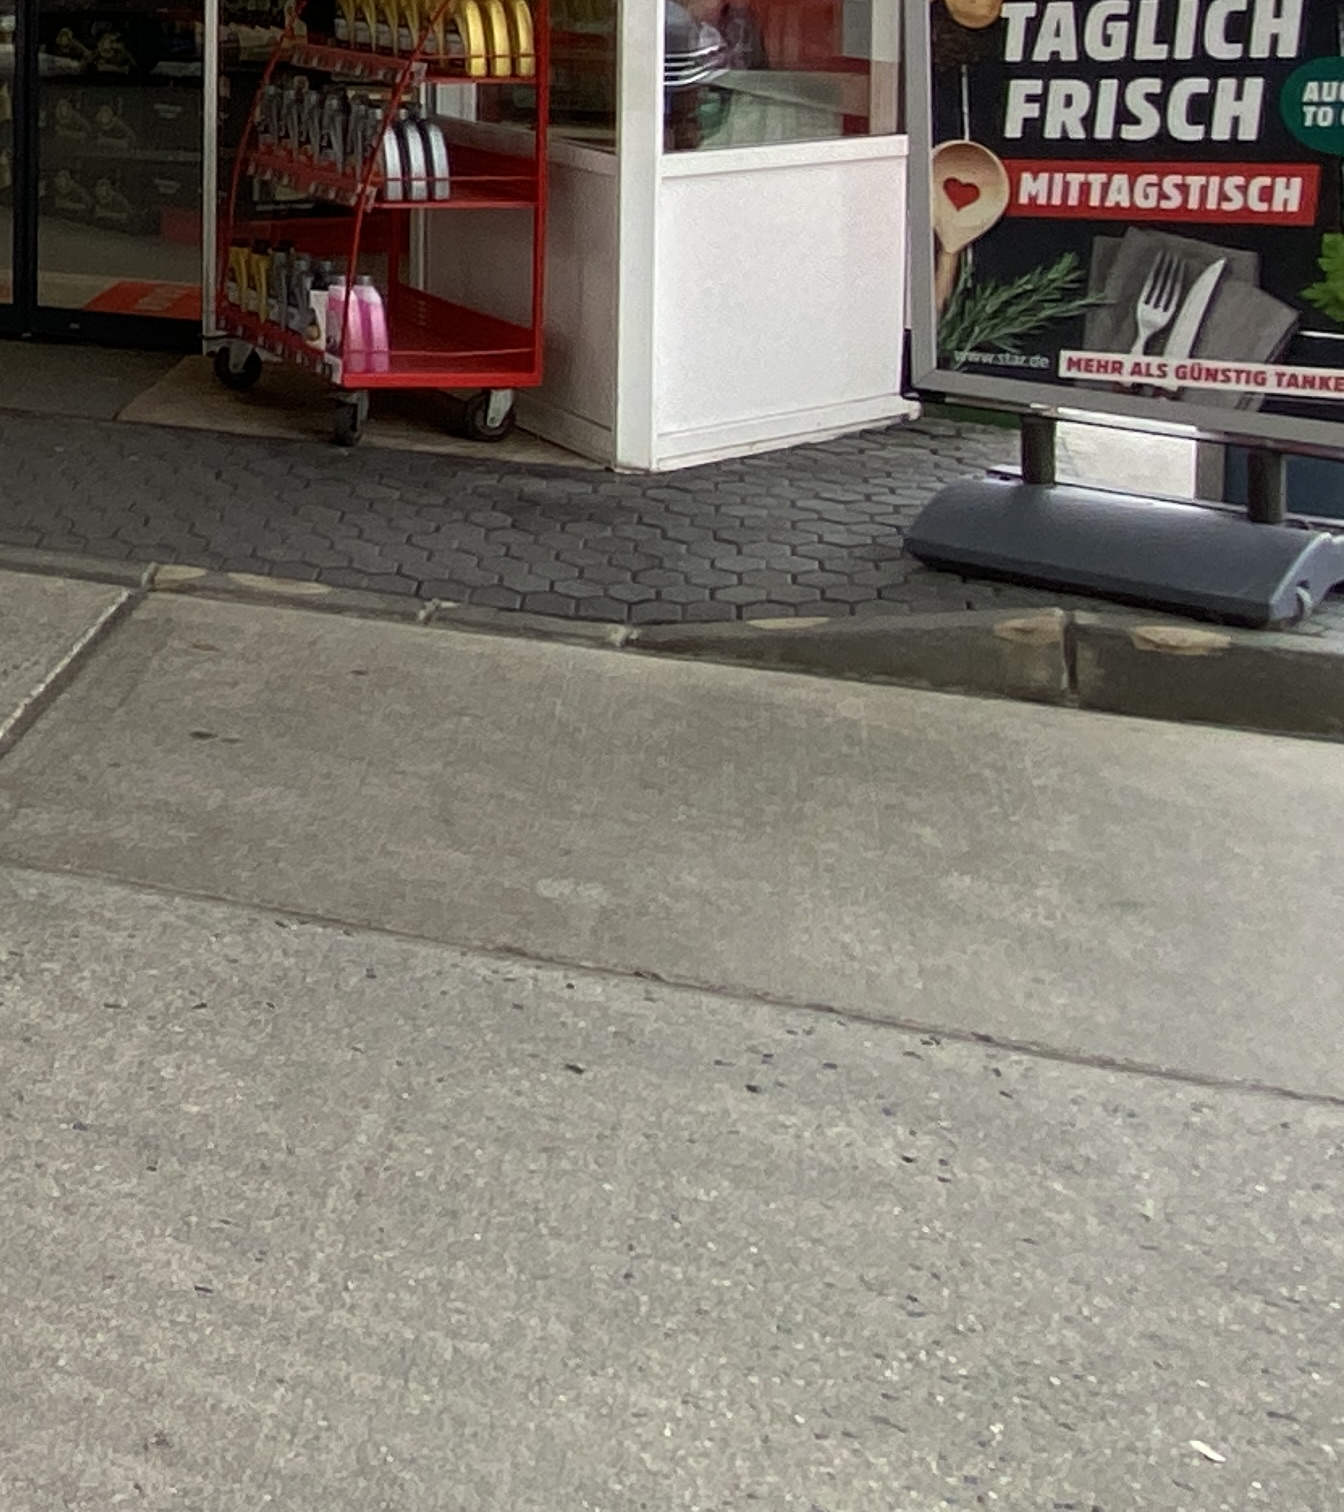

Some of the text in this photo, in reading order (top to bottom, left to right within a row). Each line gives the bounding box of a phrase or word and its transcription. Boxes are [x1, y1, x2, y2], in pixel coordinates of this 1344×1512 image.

[1003, 76, 1265, 143] FRISCH
[1302, 105, 1334, 126] TO
[1018, 171, 1302, 214] MITTAGSTISCH
[1065, 355, 1123, 376] MEHR
[1130, 361, 1168, 380] ALS
[1175, 362, 1267, 387] GÜNSTIG
